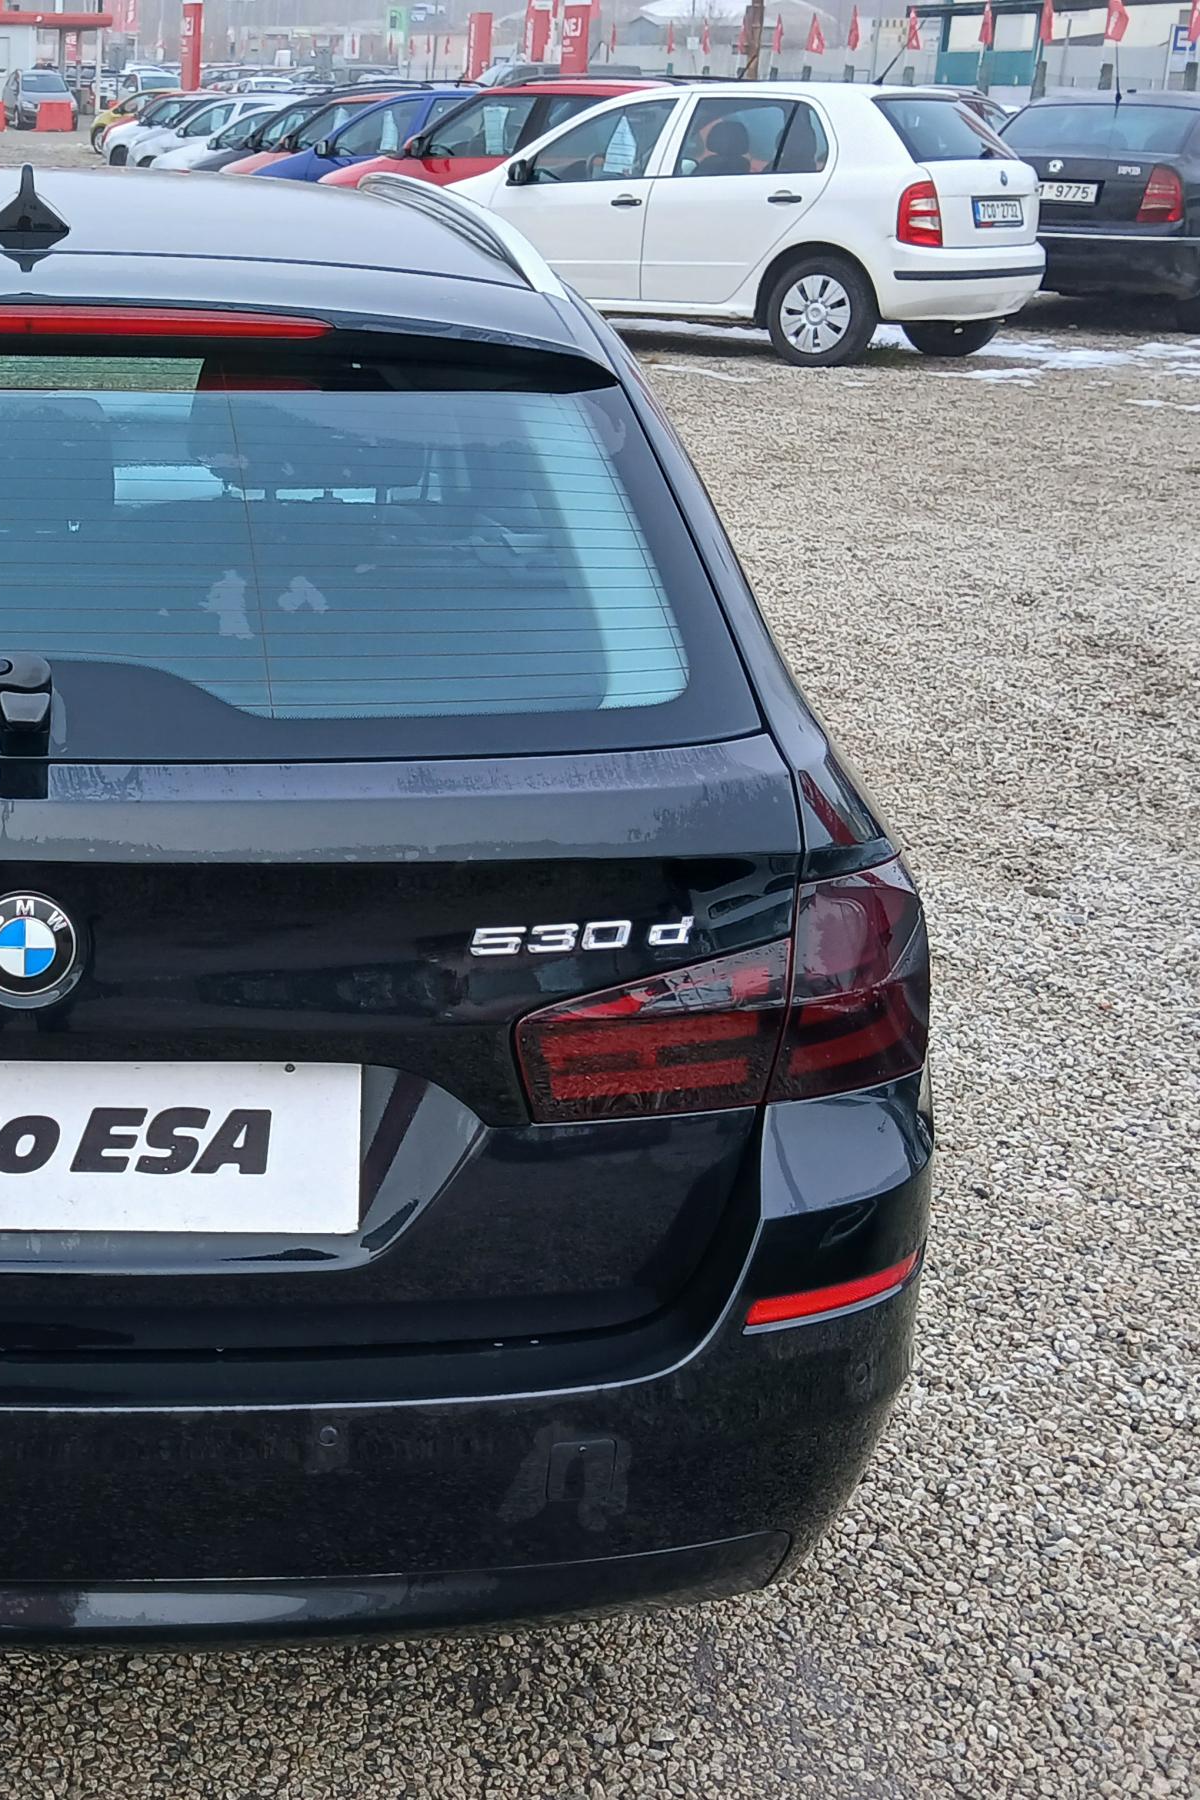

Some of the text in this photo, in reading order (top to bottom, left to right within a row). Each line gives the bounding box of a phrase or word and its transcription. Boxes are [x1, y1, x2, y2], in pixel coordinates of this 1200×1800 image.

[1055, 185, 1090, 199] 9775
[469, 915, 695, 957] 530 d
[69, 1106, 273, 1175] ESA
